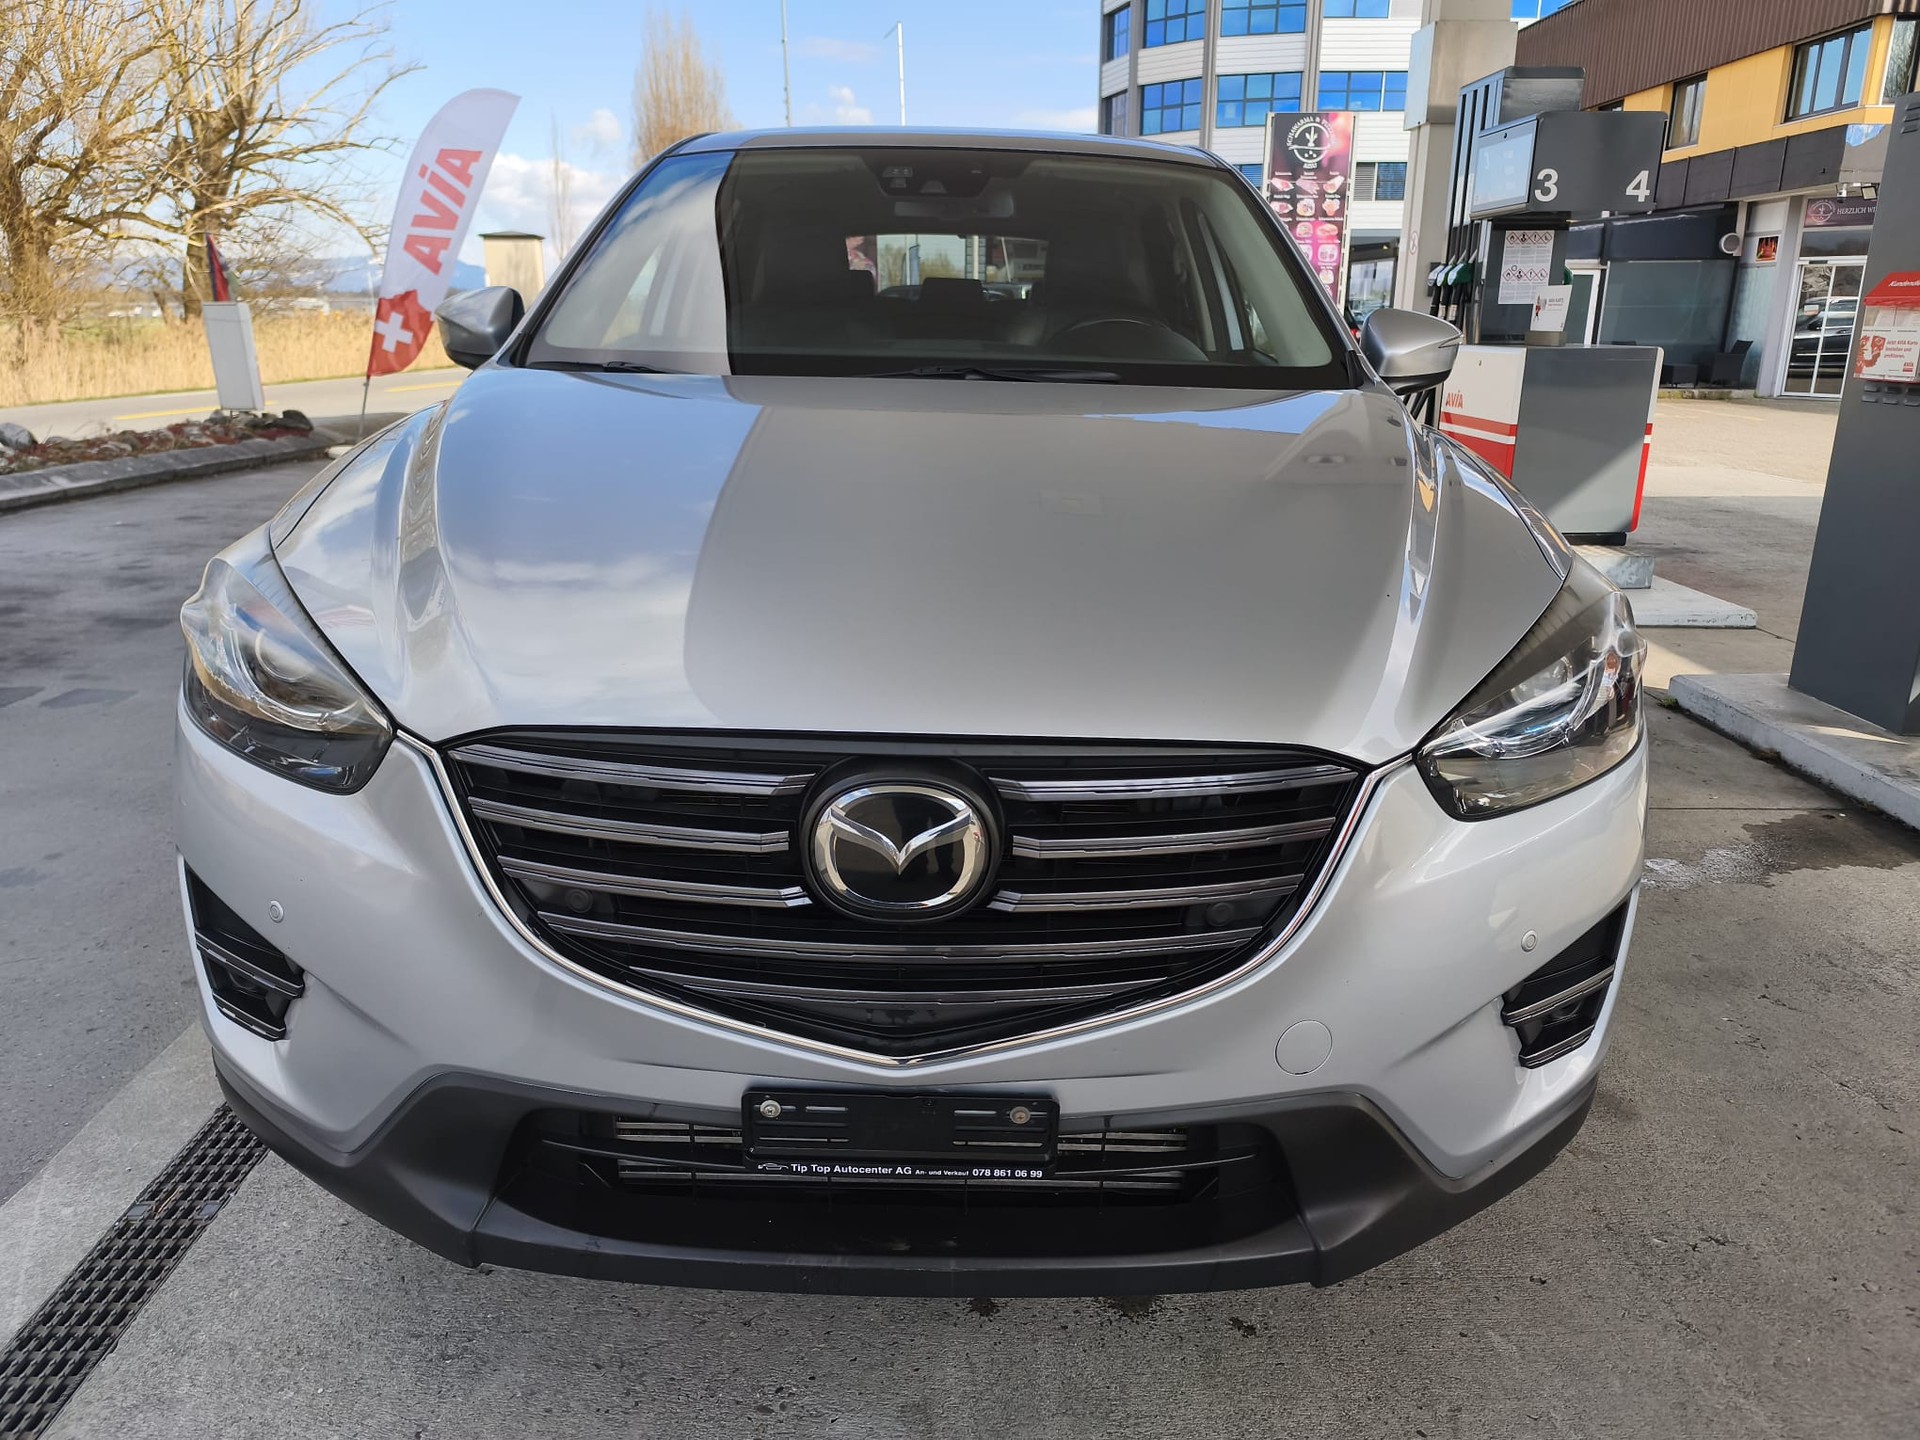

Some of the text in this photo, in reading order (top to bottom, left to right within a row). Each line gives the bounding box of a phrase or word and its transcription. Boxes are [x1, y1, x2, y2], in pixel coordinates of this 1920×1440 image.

[1535, 168, 1559, 202] 3
[1625, 170, 1650, 202] 4
[403, 149, 483, 276] AVIA
[1445, 390, 1464, 409] AVIA
[791, 1163, 808, 1174] Tip
[811, 1164, 831, 1174] Top
[833, 1164, 893, 1174] Autocenter
[895, 1166, 912, 1175] AG
[972, 1168, 991, 1177] 078
[993, 1169, 1011, 1177] 861
[1014, 1169, 1028, 1178] 06
[1030, 1170, 1043, 1178] 99
